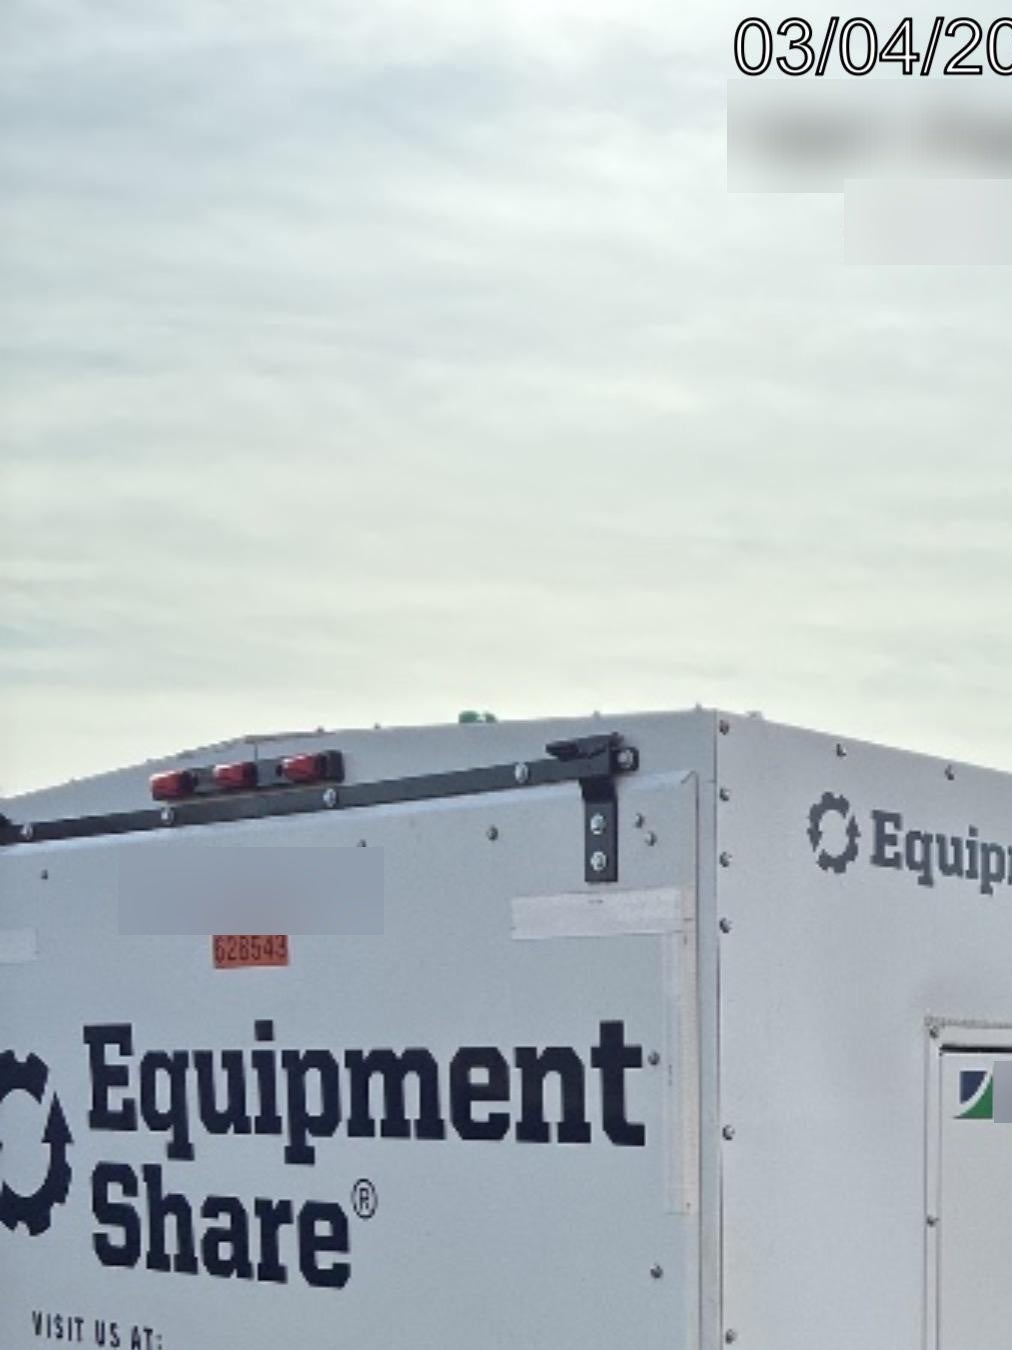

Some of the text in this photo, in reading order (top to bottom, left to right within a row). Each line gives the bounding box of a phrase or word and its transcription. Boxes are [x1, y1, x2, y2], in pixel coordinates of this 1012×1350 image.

[215, 934, 288, 963] 628543
[83, 1019, 646, 1165] Equipment
[32, 1310, 84, 1342] VISIT
[95, 1319, 120, 1348] US
